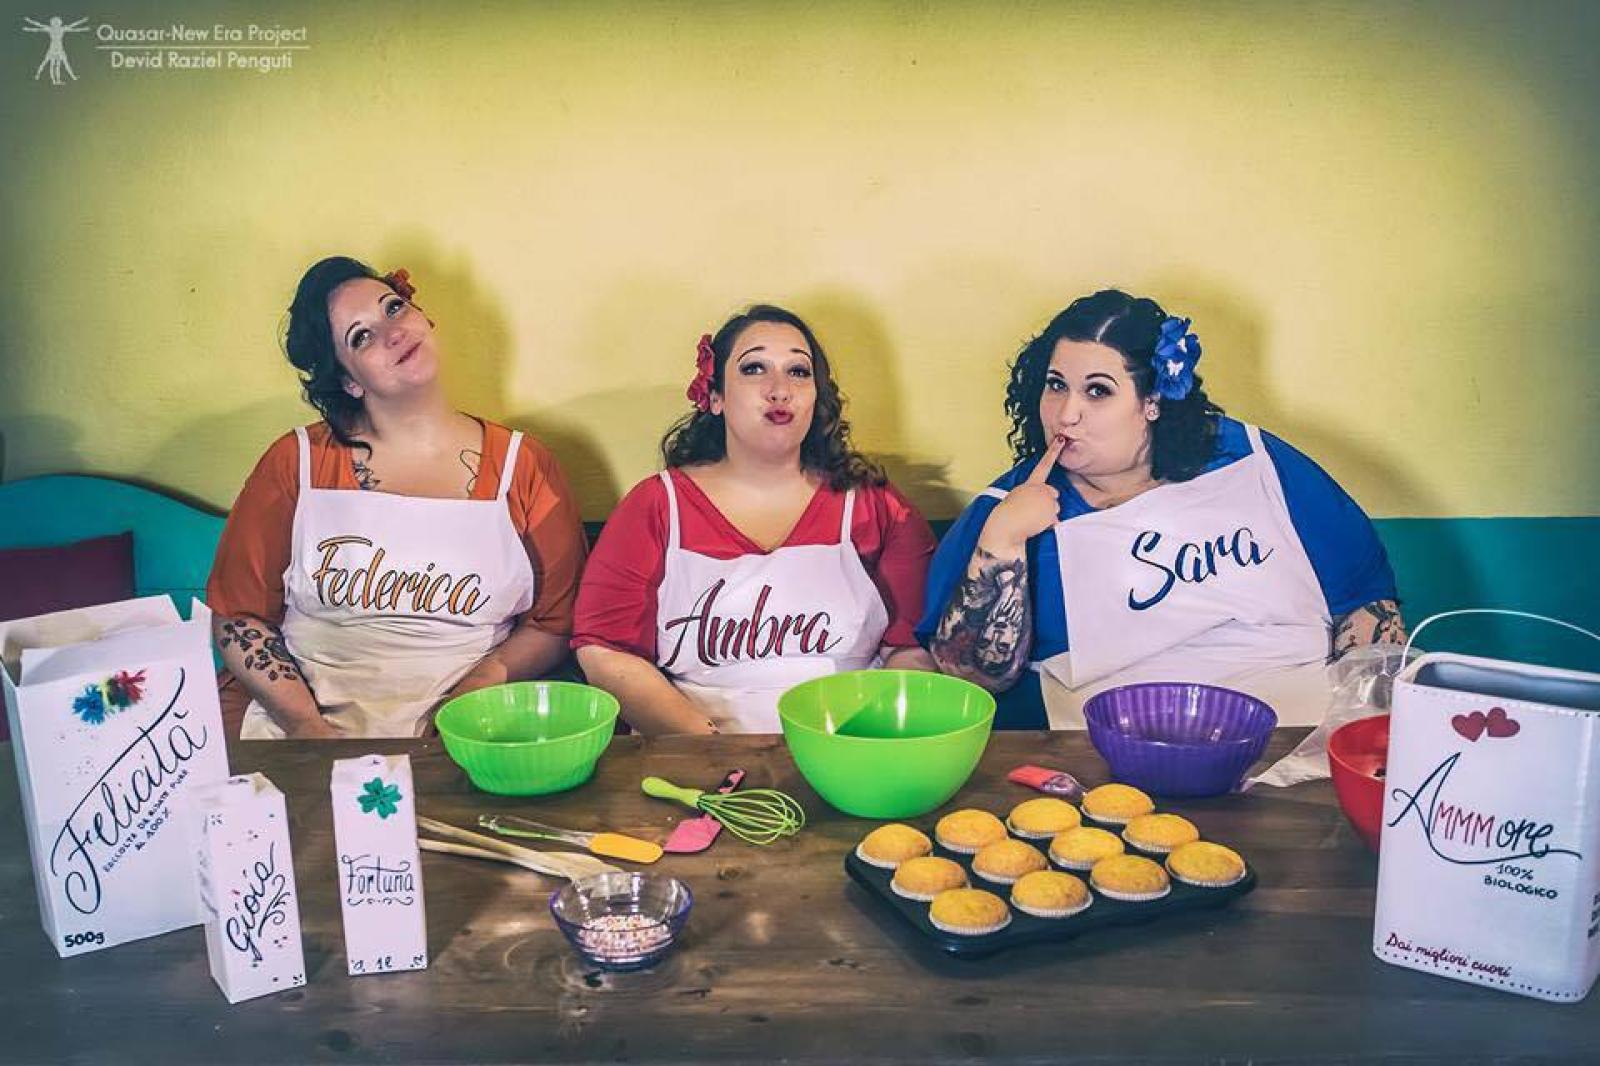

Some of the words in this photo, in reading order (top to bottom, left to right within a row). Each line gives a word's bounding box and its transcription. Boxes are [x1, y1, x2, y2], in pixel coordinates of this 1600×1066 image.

[312, 536, 490, 617] Federica
[1128, 527, 1274, 611] Sara
[665, 578, 843, 668] Ambra
[50, 667, 208, 914] Felicità
[225, 841, 275, 963] Gioia
[341, 855, 414, 894] Fortuna
[1484, 874, 1558, 900] BIOLOGICO
[1495, 864, 1534, 881] 100%
[64, 930, 106, 948] 500g
[1385, 932, 1413, 952] Dai
[1415, 946, 1471, 967] migliori
[1470, 960, 1513, 978] cuori
